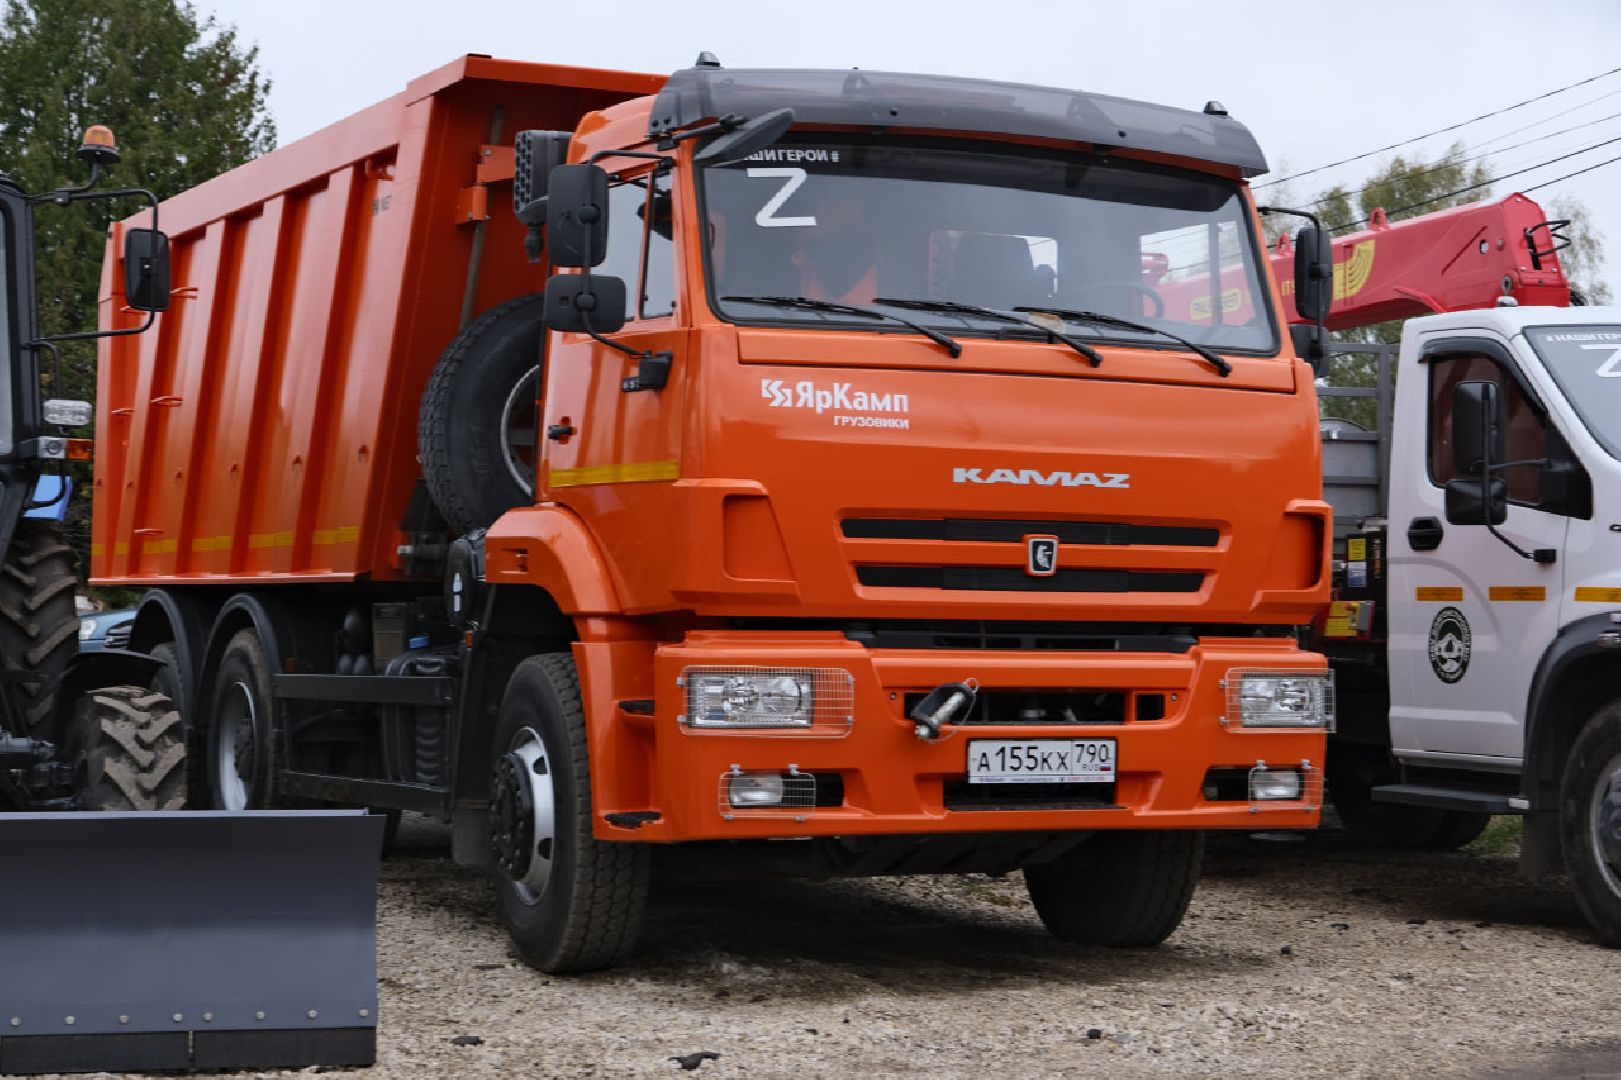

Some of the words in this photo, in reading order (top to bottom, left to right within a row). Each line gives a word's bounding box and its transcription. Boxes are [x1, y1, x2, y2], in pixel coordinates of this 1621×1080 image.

[747, 167, 817, 227] Z
[796, 381, 909, 414] ЯрКамп
[833, 415, 909, 429] ГРУЗОВИКИ
[952, 467, 1130, 488] KAMAZ
[1075, 743, 1109, 763] 790
